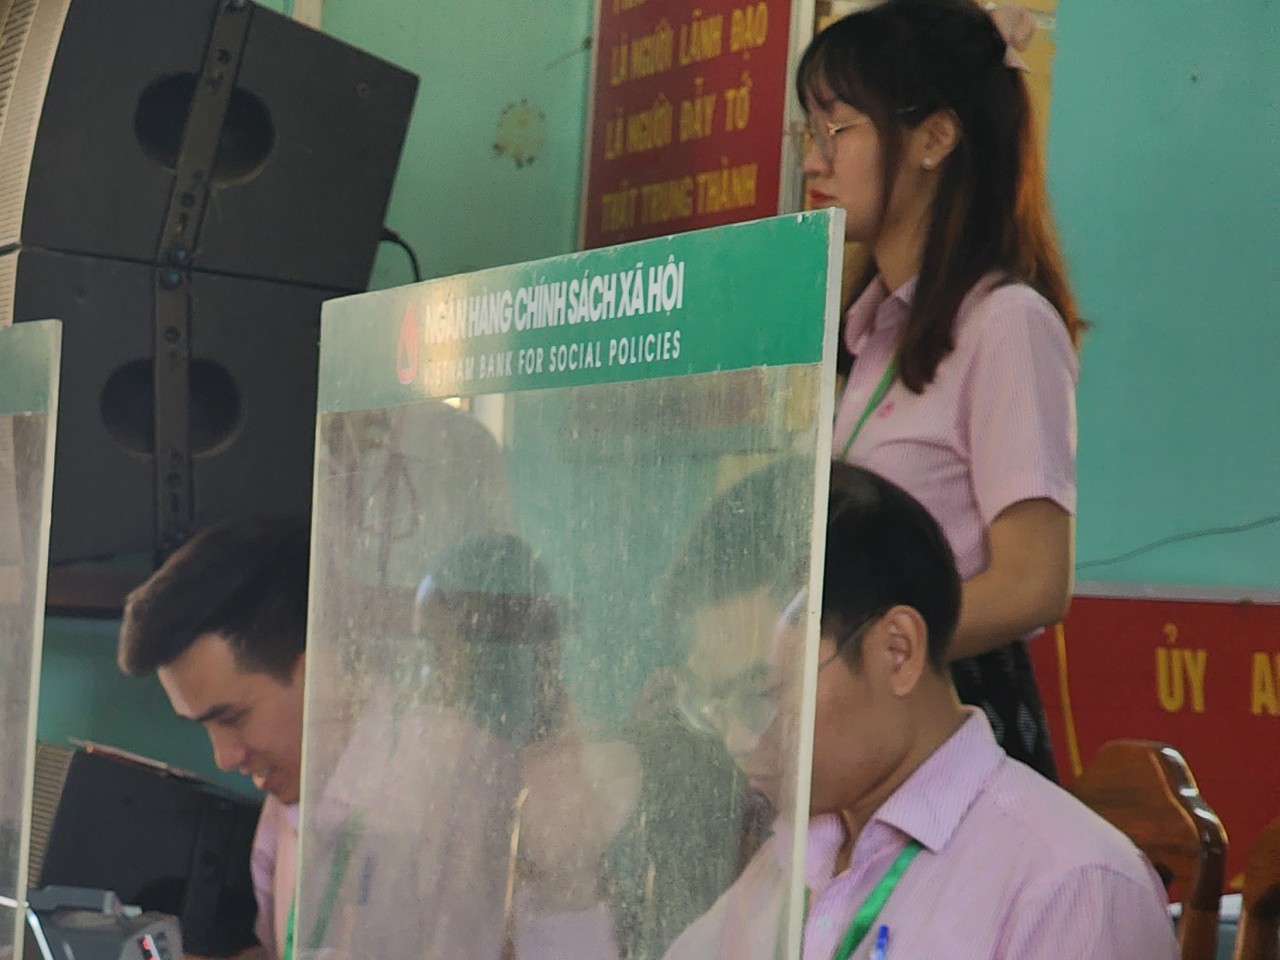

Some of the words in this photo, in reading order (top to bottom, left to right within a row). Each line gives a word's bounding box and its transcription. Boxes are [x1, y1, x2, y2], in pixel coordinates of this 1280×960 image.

[469, 286, 513, 338] HÀNG
[514, 276, 568, 331] CHÍNH
[568, 269, 617, 325] SÁCH
[617, 262, 644, 317] XÃ
[646, 254, 685, 317] HỘI
[479, 350, 513, 380] BANK
[519, 344, 544, 374] FOR
[549, 341, 602, 373] SOCIAL
[608, 330, 681, 367] POLICIES
[1155, 623, 1208, 714] ỦY
